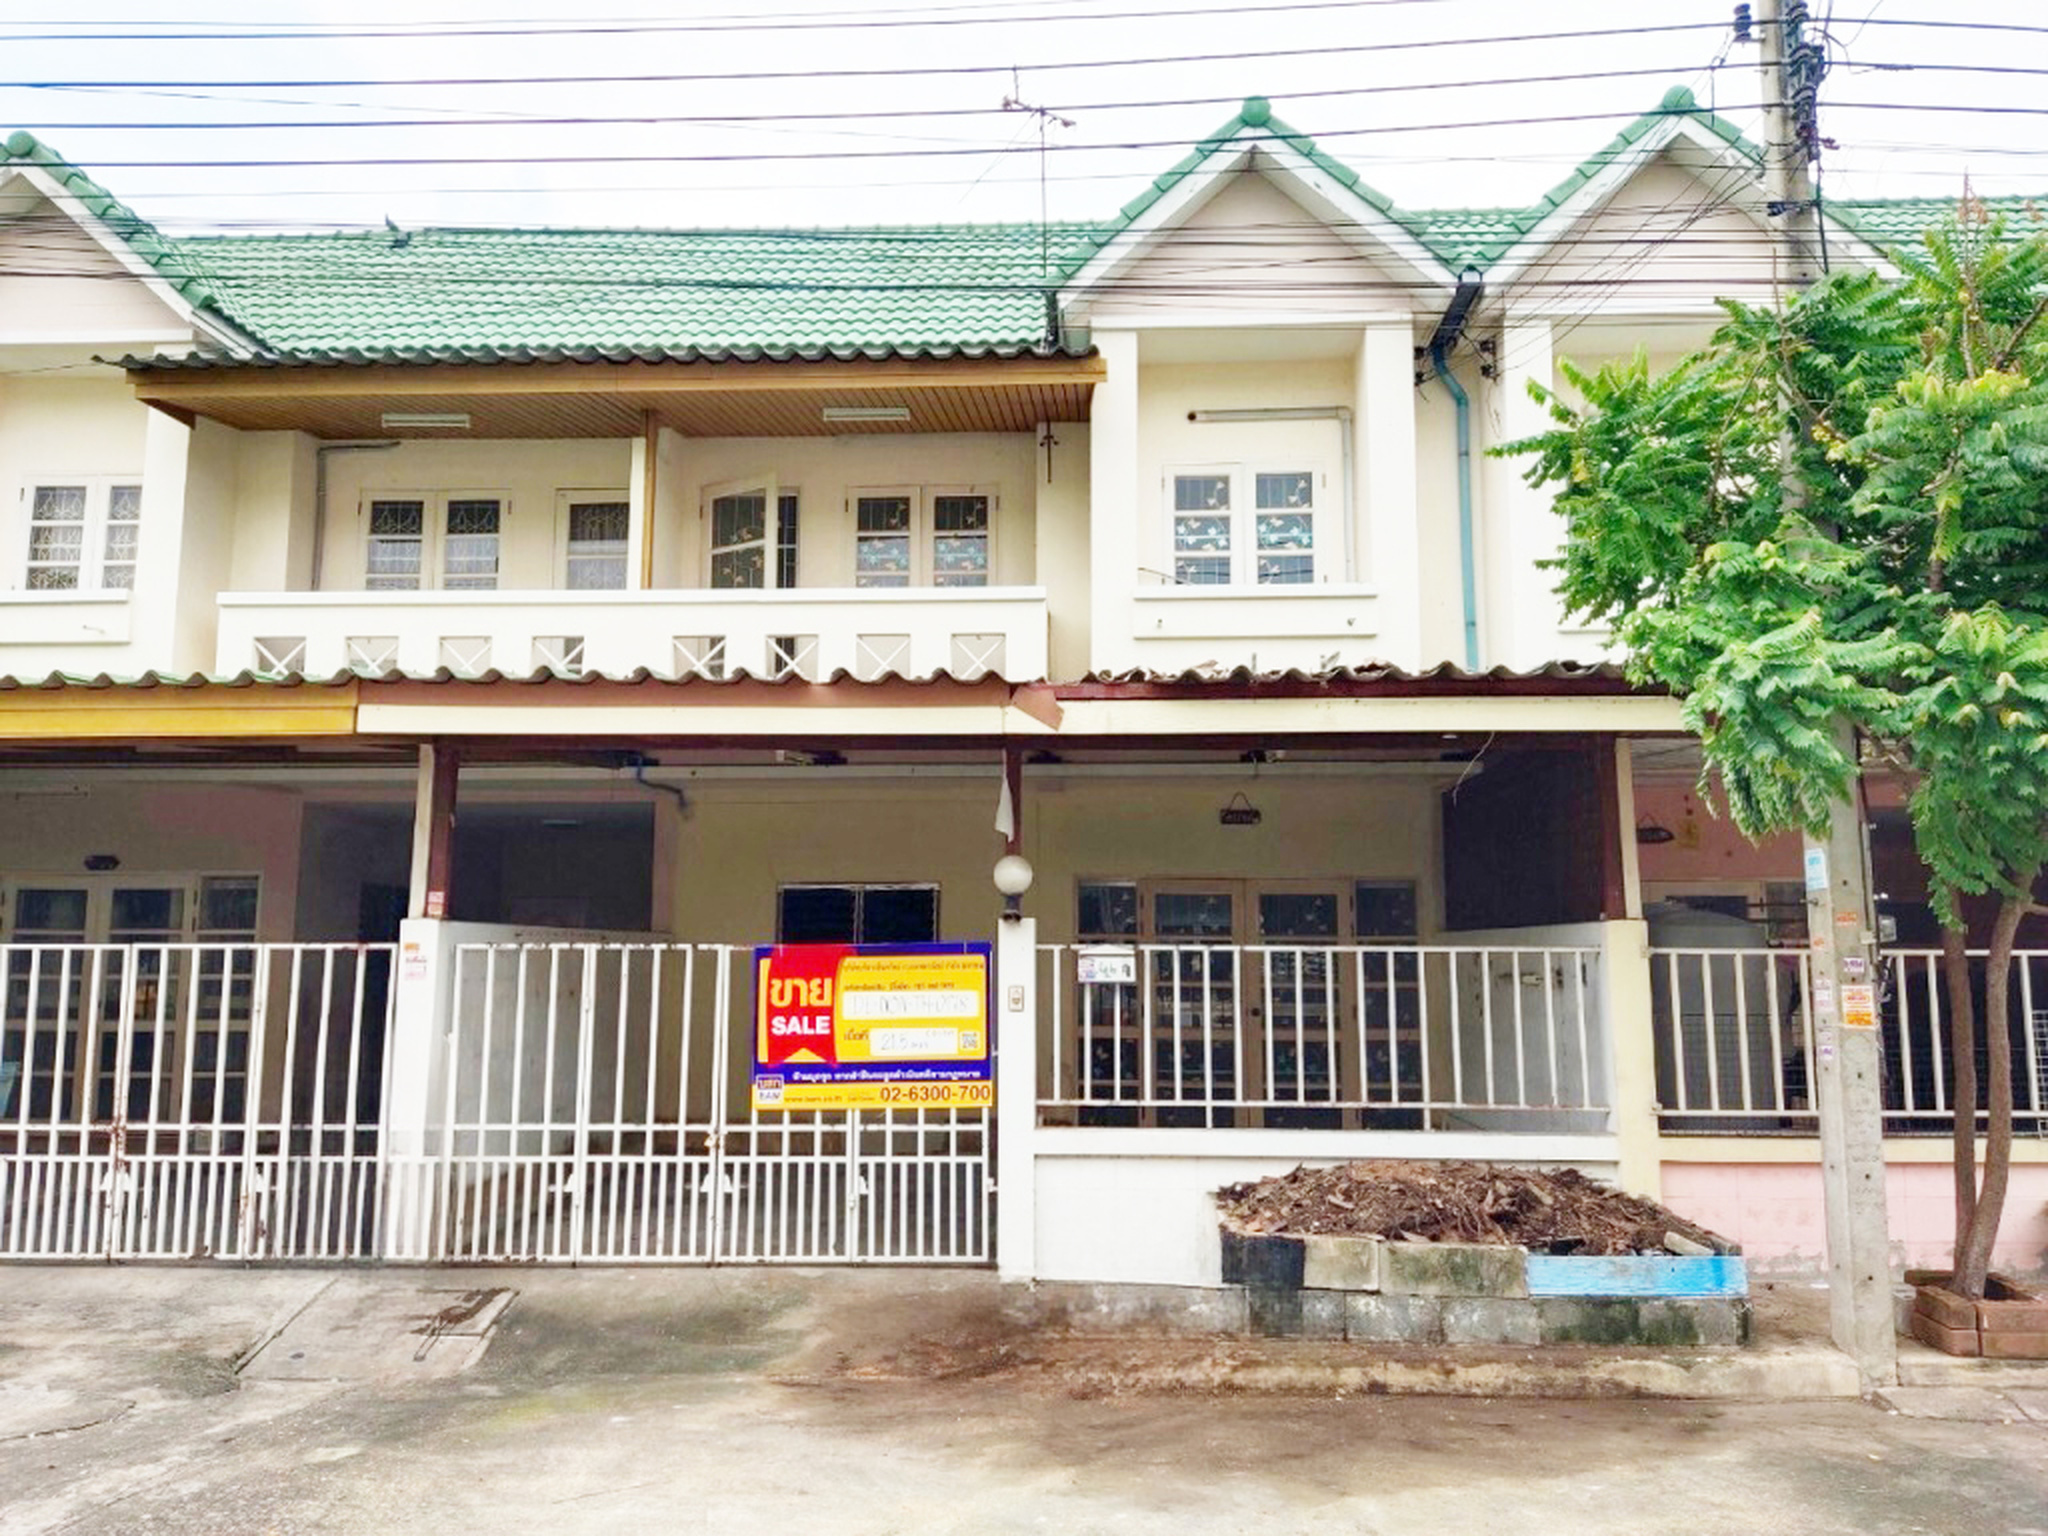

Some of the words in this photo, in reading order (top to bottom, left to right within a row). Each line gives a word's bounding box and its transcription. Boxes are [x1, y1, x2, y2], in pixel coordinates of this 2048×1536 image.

[770, 978, 832, 1007] ขาย
[771, 1016, 831, 1036] SALE
[879, 1084, 991, 1102] 02-6300-700
